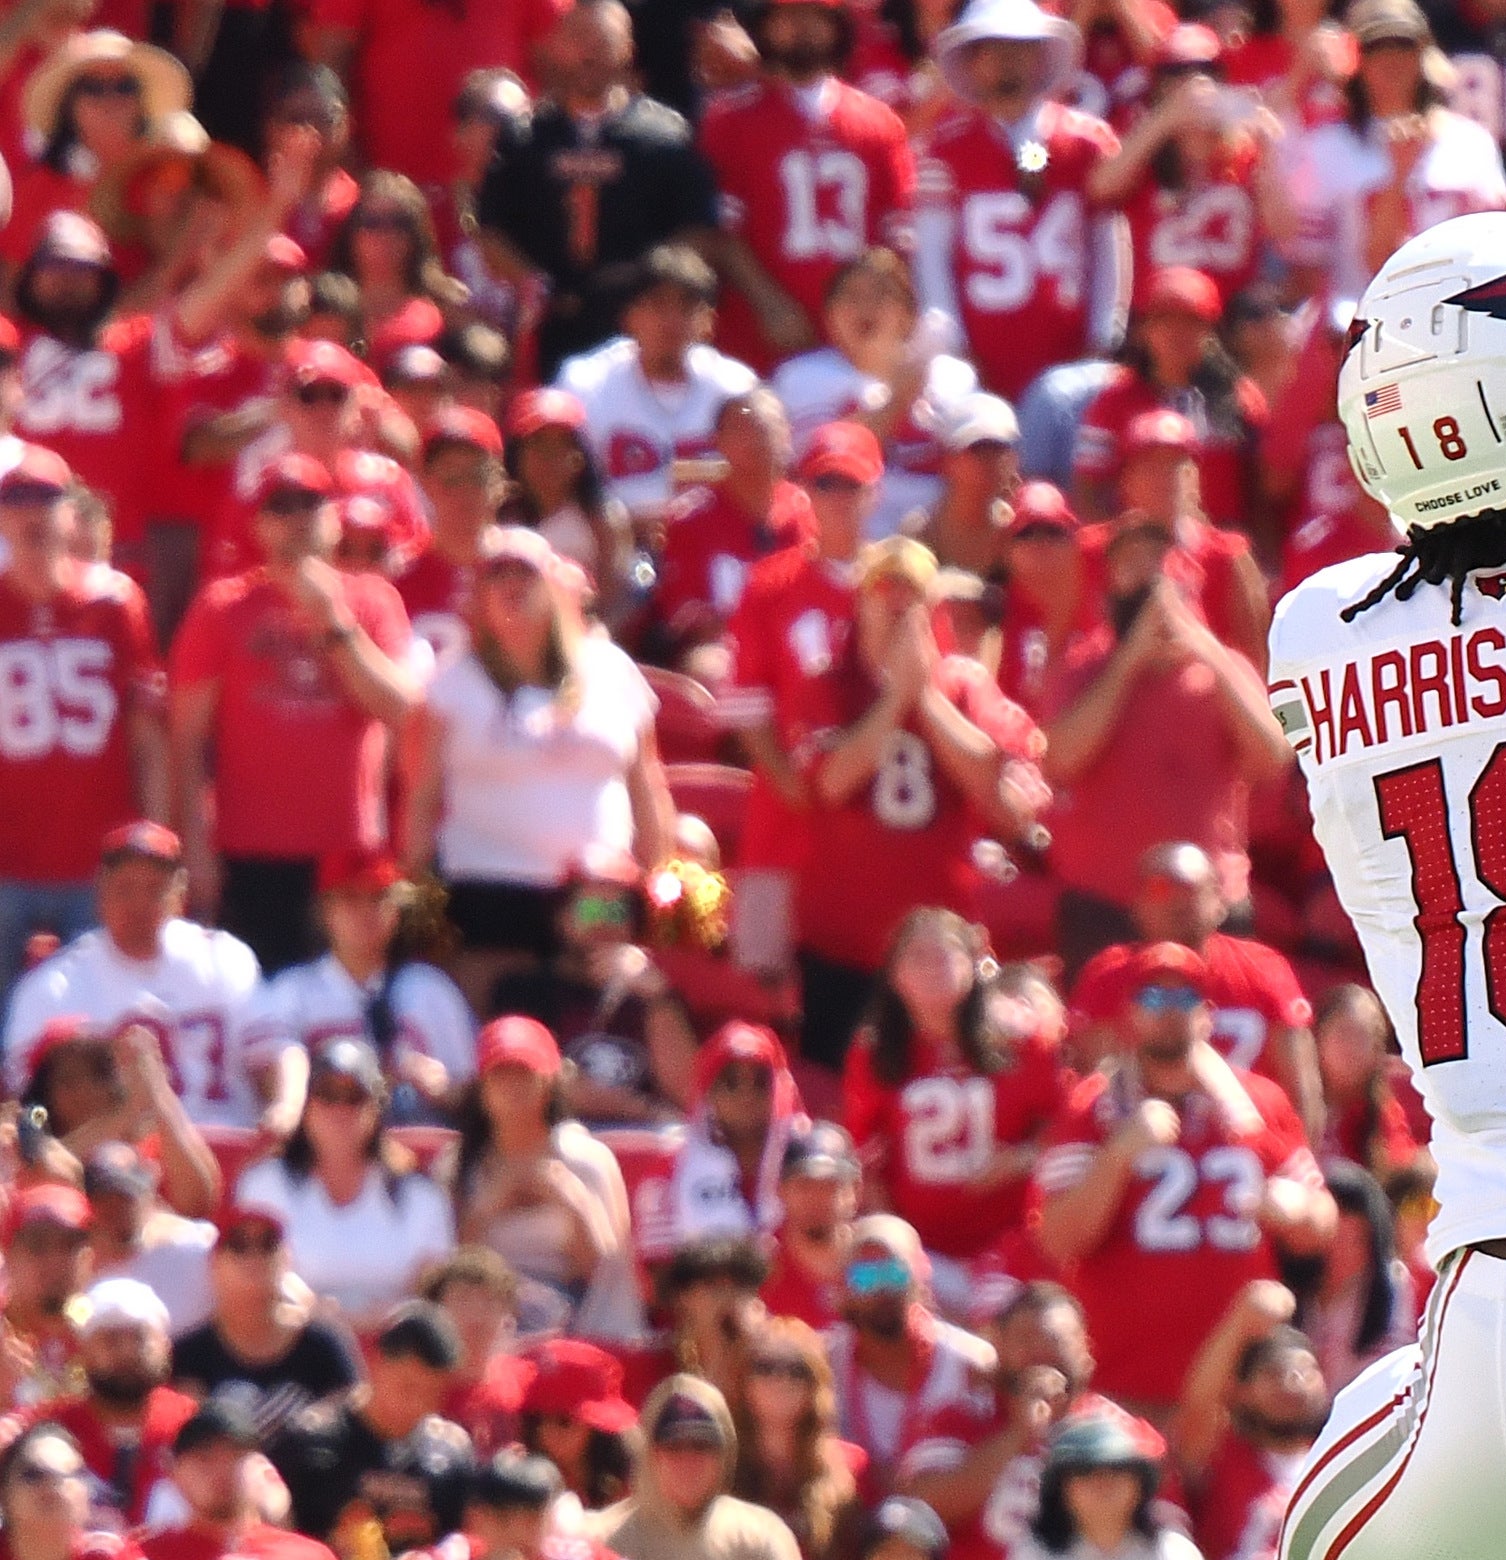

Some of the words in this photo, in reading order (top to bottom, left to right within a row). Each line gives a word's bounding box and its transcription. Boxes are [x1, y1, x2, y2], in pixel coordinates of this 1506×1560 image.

[781, 149, 868, 261] 13
[964, 190, 1082, 310] 54
[1397, 415, 1467, 470] 18
[1414, 492, 1464, 513] CHOOSE
[1465, 479, 1501, 500] LOVE
[0, 637, 117, 759] 85
[904, 1073, 995, 1184] 21
[1133, 1146, 1266, 1253] 23
